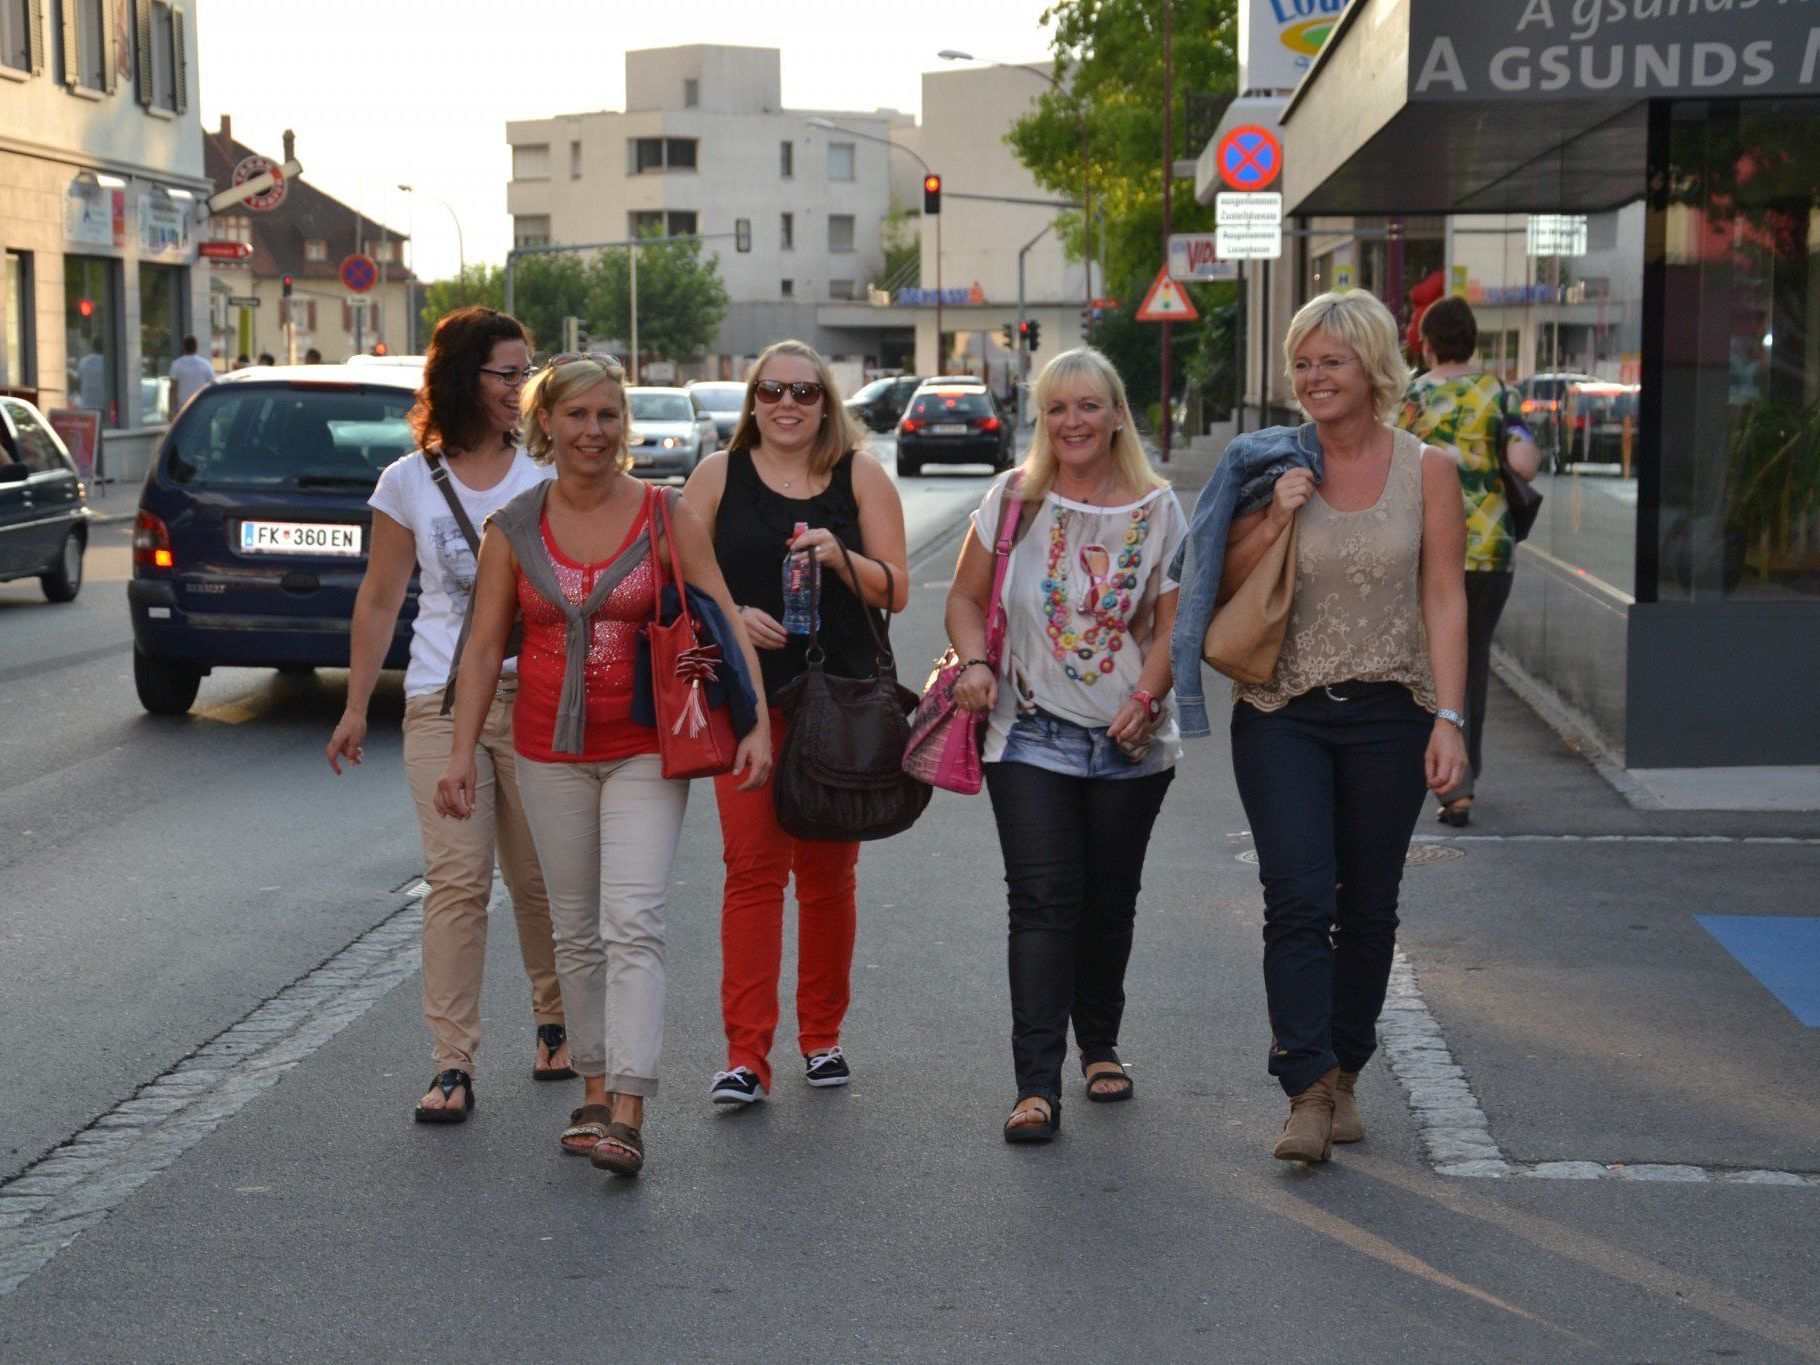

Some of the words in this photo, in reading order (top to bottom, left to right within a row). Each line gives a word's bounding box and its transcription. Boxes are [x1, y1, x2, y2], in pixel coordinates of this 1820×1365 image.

[1570, 0, 1760, 40] gsun
[1414, 36, 1468, 92] A
[1489, 41, 1774, 91] GSUNDS
[258, 526, 280, 545] FK
[293, 528, 327, 547] 360
[331, 529, 354, 548] EN
